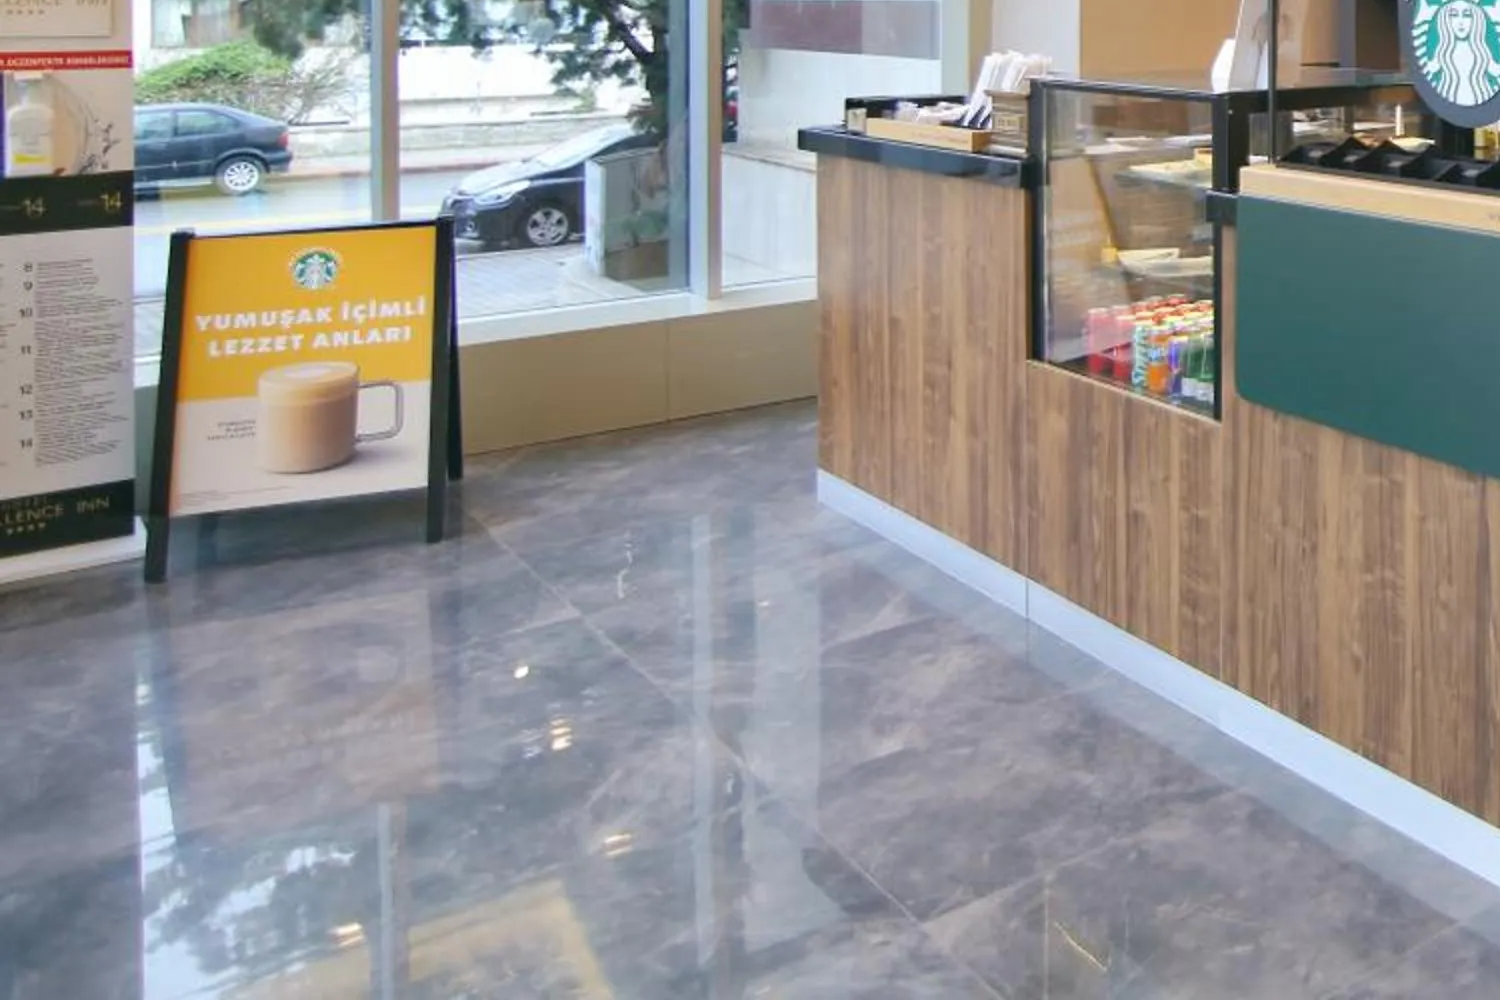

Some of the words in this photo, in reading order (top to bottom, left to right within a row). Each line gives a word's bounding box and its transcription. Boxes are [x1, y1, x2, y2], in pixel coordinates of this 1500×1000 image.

[195, 306, 333, 331] YUMUŞAK
[341, 294, 427, 325] İÇİMLİ
[208, 332, 304, 358] LEZZET
[311, 324, 412, 349] ANLARI
